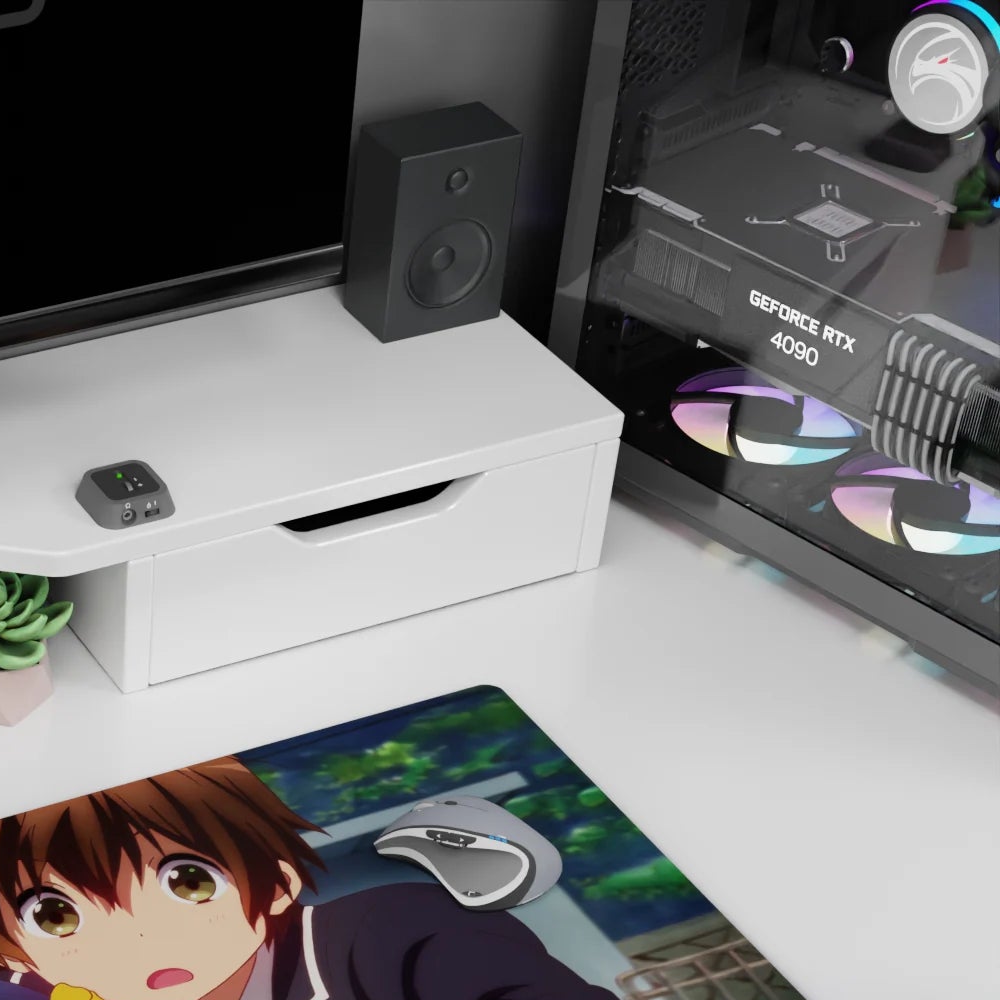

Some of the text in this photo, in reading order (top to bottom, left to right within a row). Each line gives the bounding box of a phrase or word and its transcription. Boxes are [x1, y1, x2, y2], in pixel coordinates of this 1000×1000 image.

[749, 289, 857, 354] GEFORCE RTX
[769, 331, 819, 367] 4090
